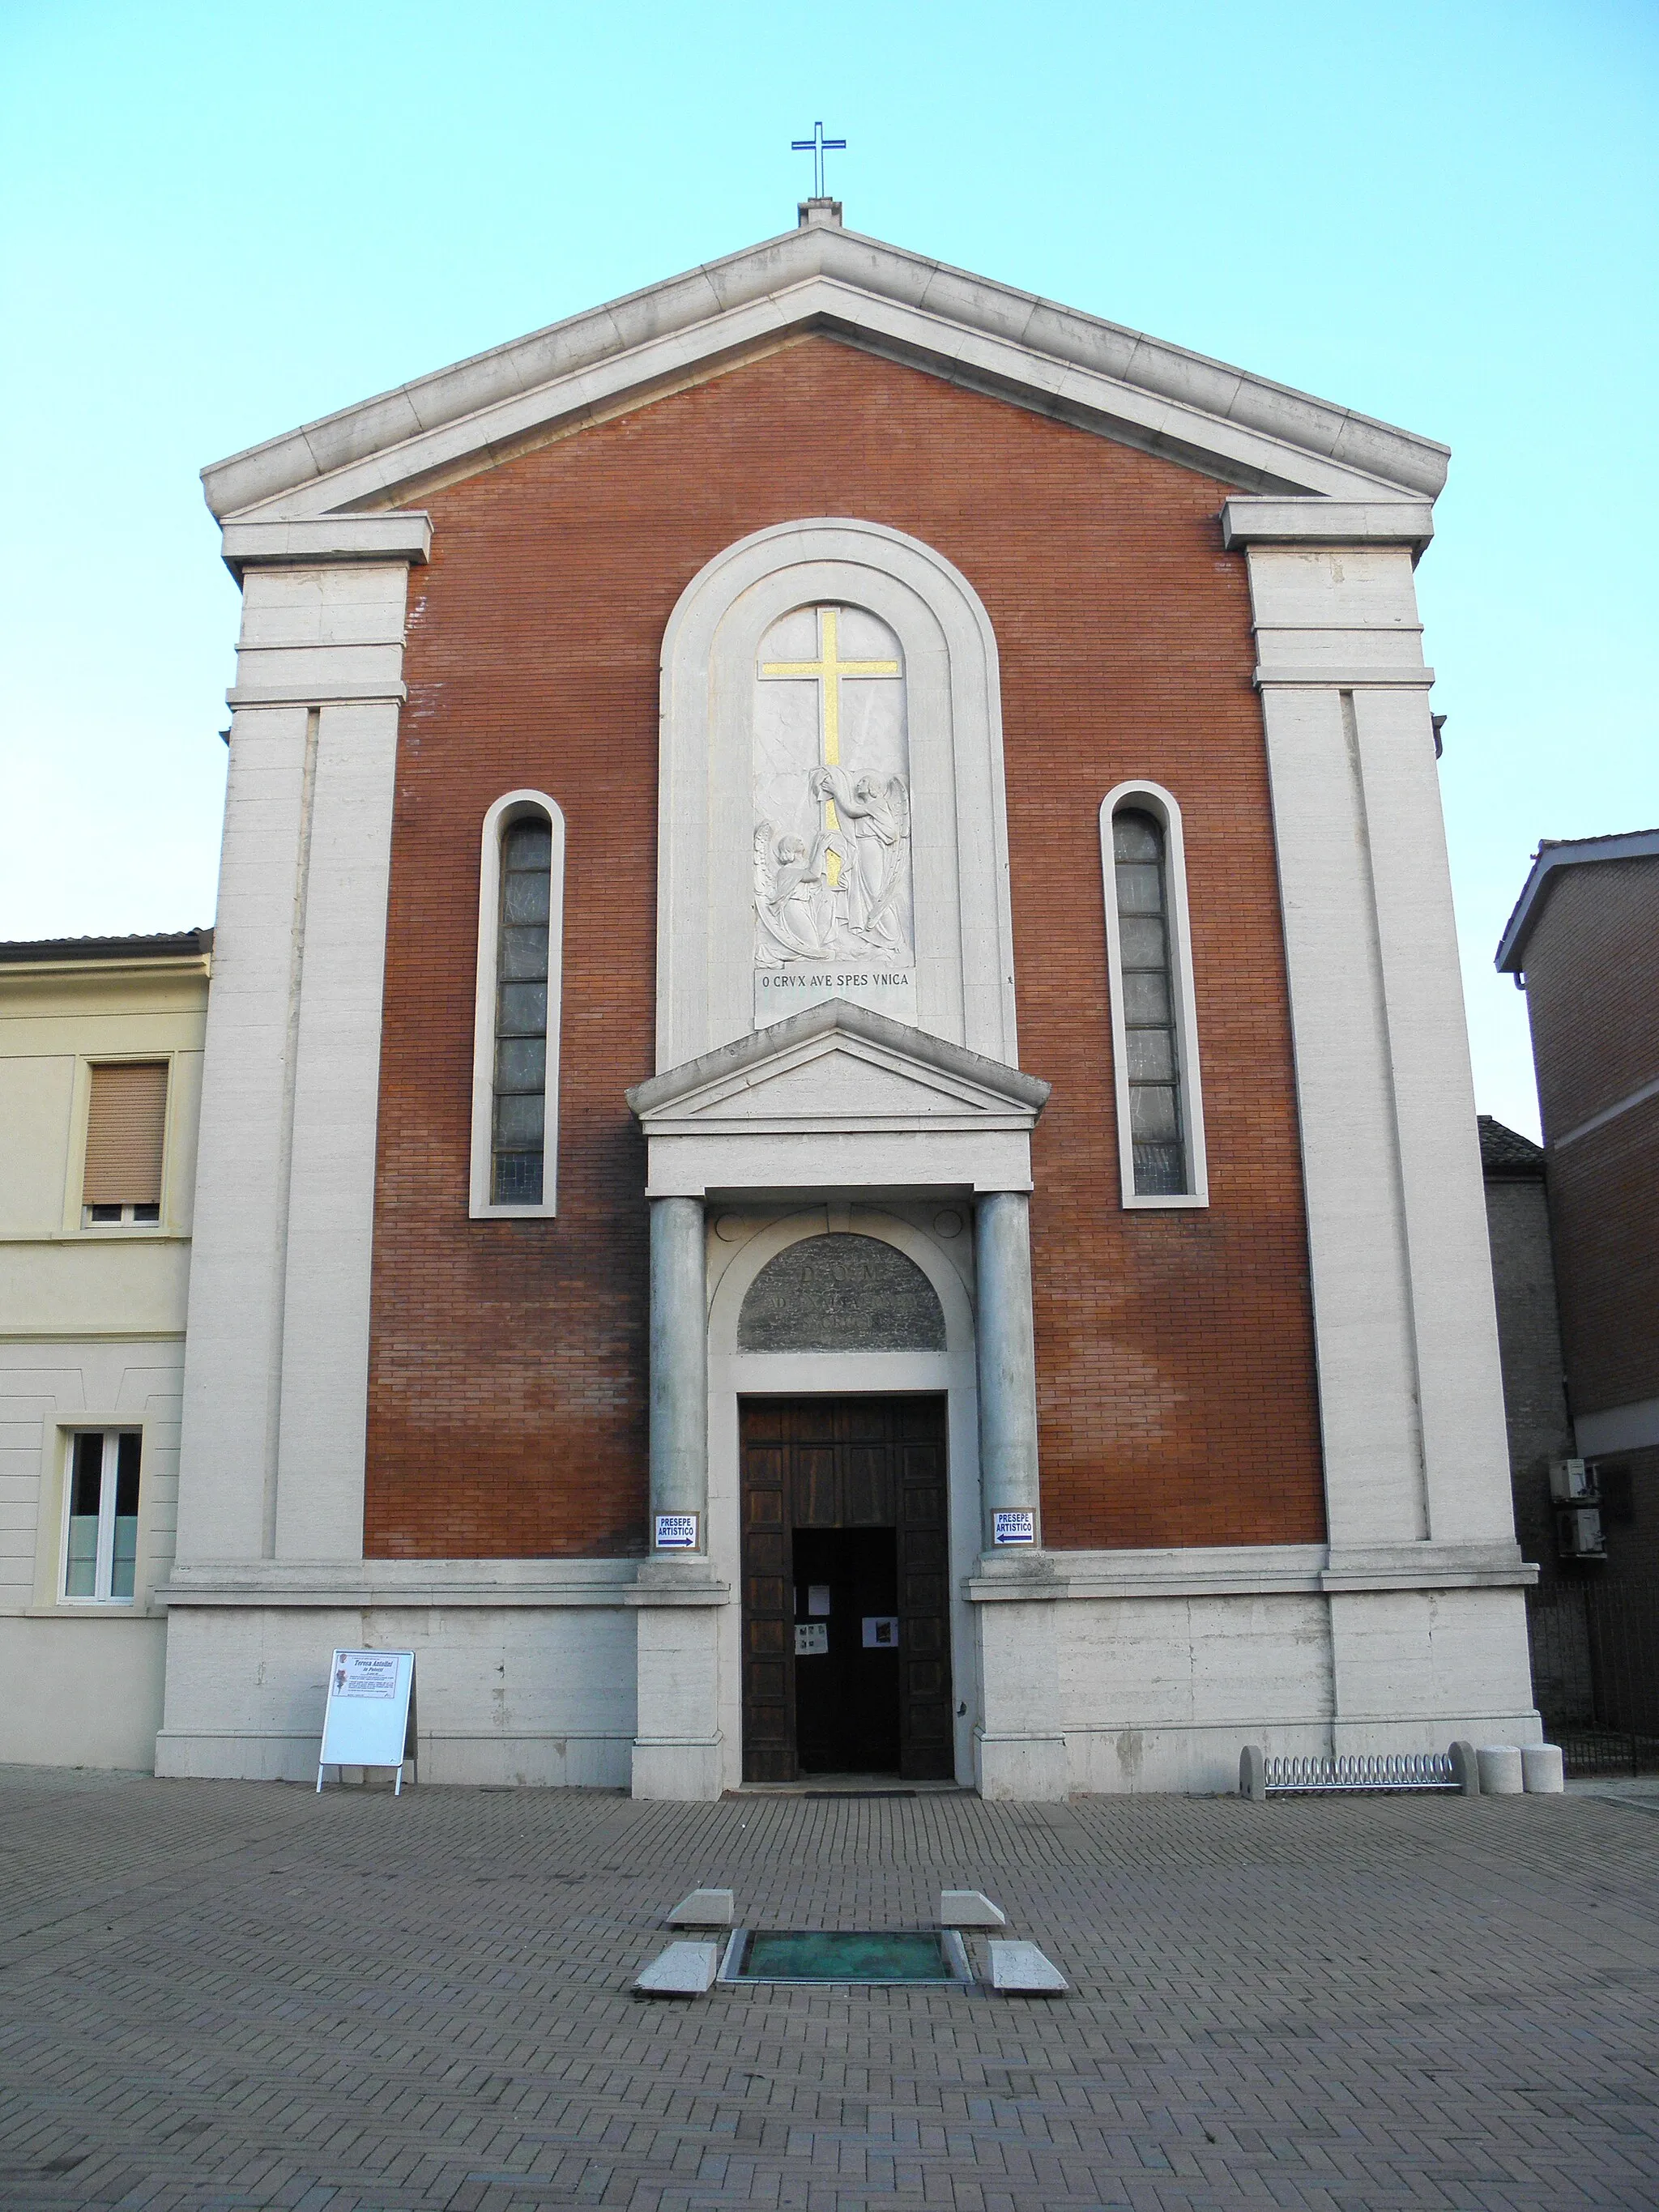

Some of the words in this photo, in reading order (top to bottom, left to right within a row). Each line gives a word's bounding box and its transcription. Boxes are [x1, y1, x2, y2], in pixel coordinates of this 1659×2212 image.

[762, 976, 770, 987] O
[774, 975, 806, 987] CRVX
[810, 974, 833, 987] AVE
[837, 974, 868, 986] SPES
[872, 974, 909, 985] VNICA
[660, 1518, 691, 1527] PRESEPE
[998, 1514, 1030, 1523] PRESEPE
[658, 1527, 694, 1536] ARTISTICO
[996, 1523, 1032, 1532] ARTISTICO
